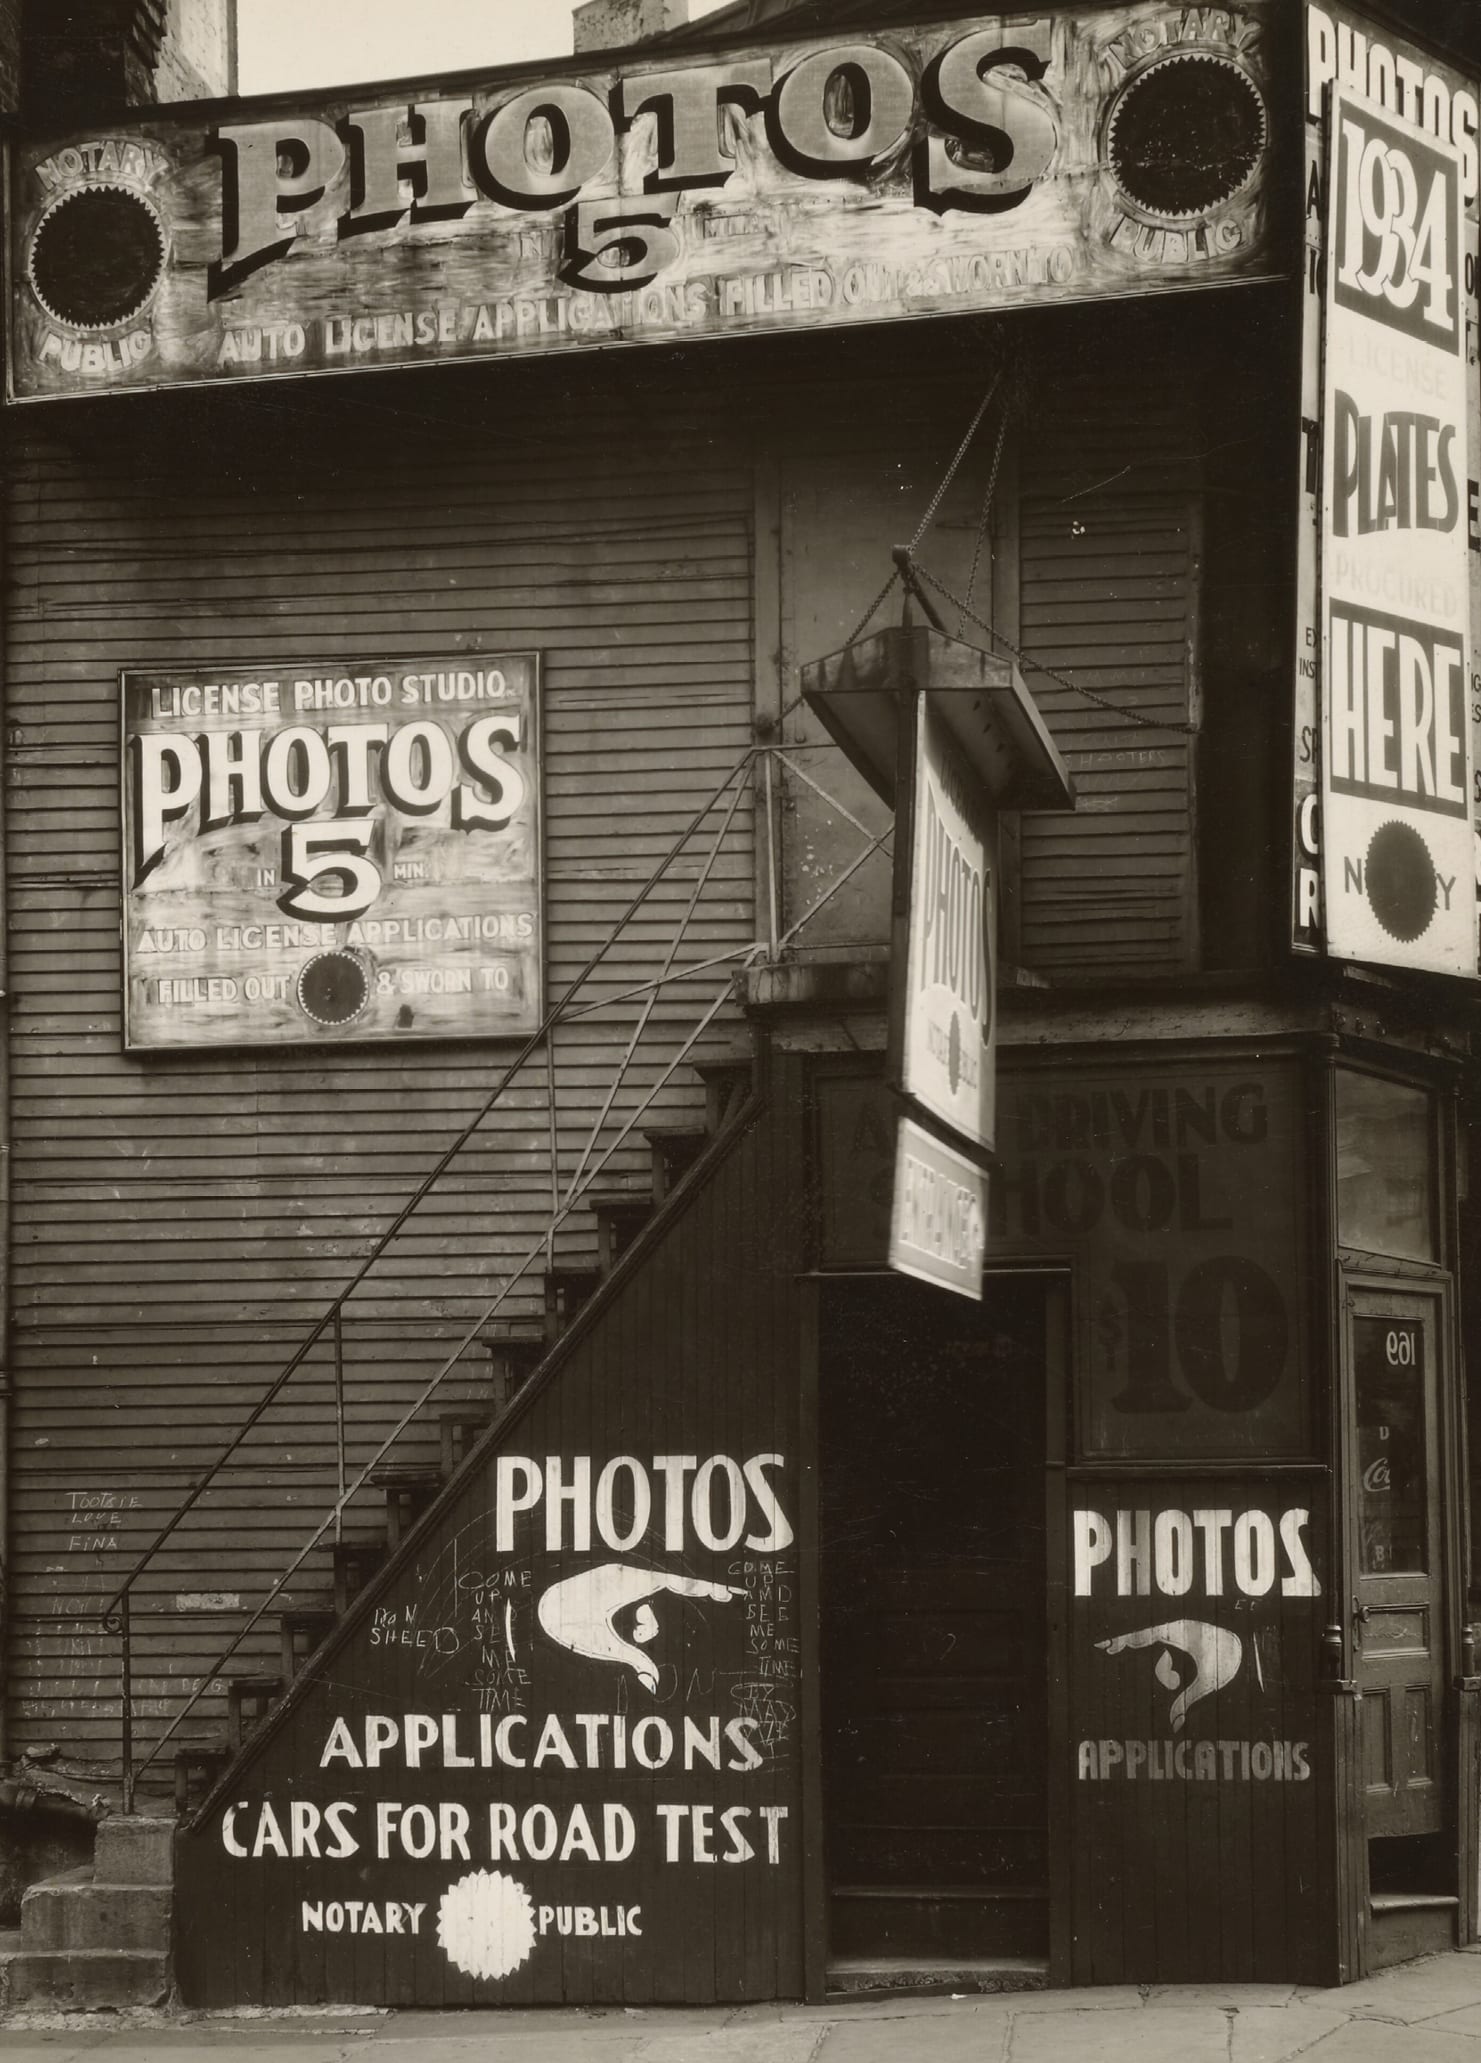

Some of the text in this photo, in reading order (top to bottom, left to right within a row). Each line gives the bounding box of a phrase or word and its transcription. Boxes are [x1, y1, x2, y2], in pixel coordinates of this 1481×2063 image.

[1108, 8, 1260, 70] NOTARY
[1308, 5, 1478, 199] PHOTOS
[35, 141, 169, 191] NOTARY
[208, 18, 1057, 300] PHOTOS
[557, 190, 683, 294] 5
[1110, 215, 1242, 263] PUBLIC
[1338, 119, 1453, 331] 1934
[39, 331, 151, 373] PUBLIC
[217, 325, 306, 367] AUTO
[325, 303, 456, 354] LICENSE
[471, 281, 707, 340] APPLICATIONS
[1334, 388, 1457, 538] PLATES
[152, 670, 507, 718] LICENSE PHOTO STUDIO
[1332, 616, 1465, 804] HERE
[131, 715, 525, 890] PHOTOS
[256, 868, 276, 887] IN
[276, 819, 383, 923] 5
[1344, 856, 1456, 911] N Y
[137, 914, 534, 953] AUTO LICENSE APPLICATIONS
[922, 779, 992, 1049] PHOTOS
[158, 967, 509, 1004] FILLED OUT & SWORN TO
[1015, 1083, 1268, 1150] DRIVING
[496, 1453, 794, 1553] PHOTOS
[458, 1571, 532, 1590] COME
[1073, 1508, 1322, 1597] PHOTOS
[319, 1714, 767, 1771] APPLICATIONS
[1078, 1739, 1311, 1781] APPLICATIONS
[221, 1801, 789, 1865] CARS FOR ROAD TEST
[301, 1900, 643, 1936] NOTARY PUBLIC
